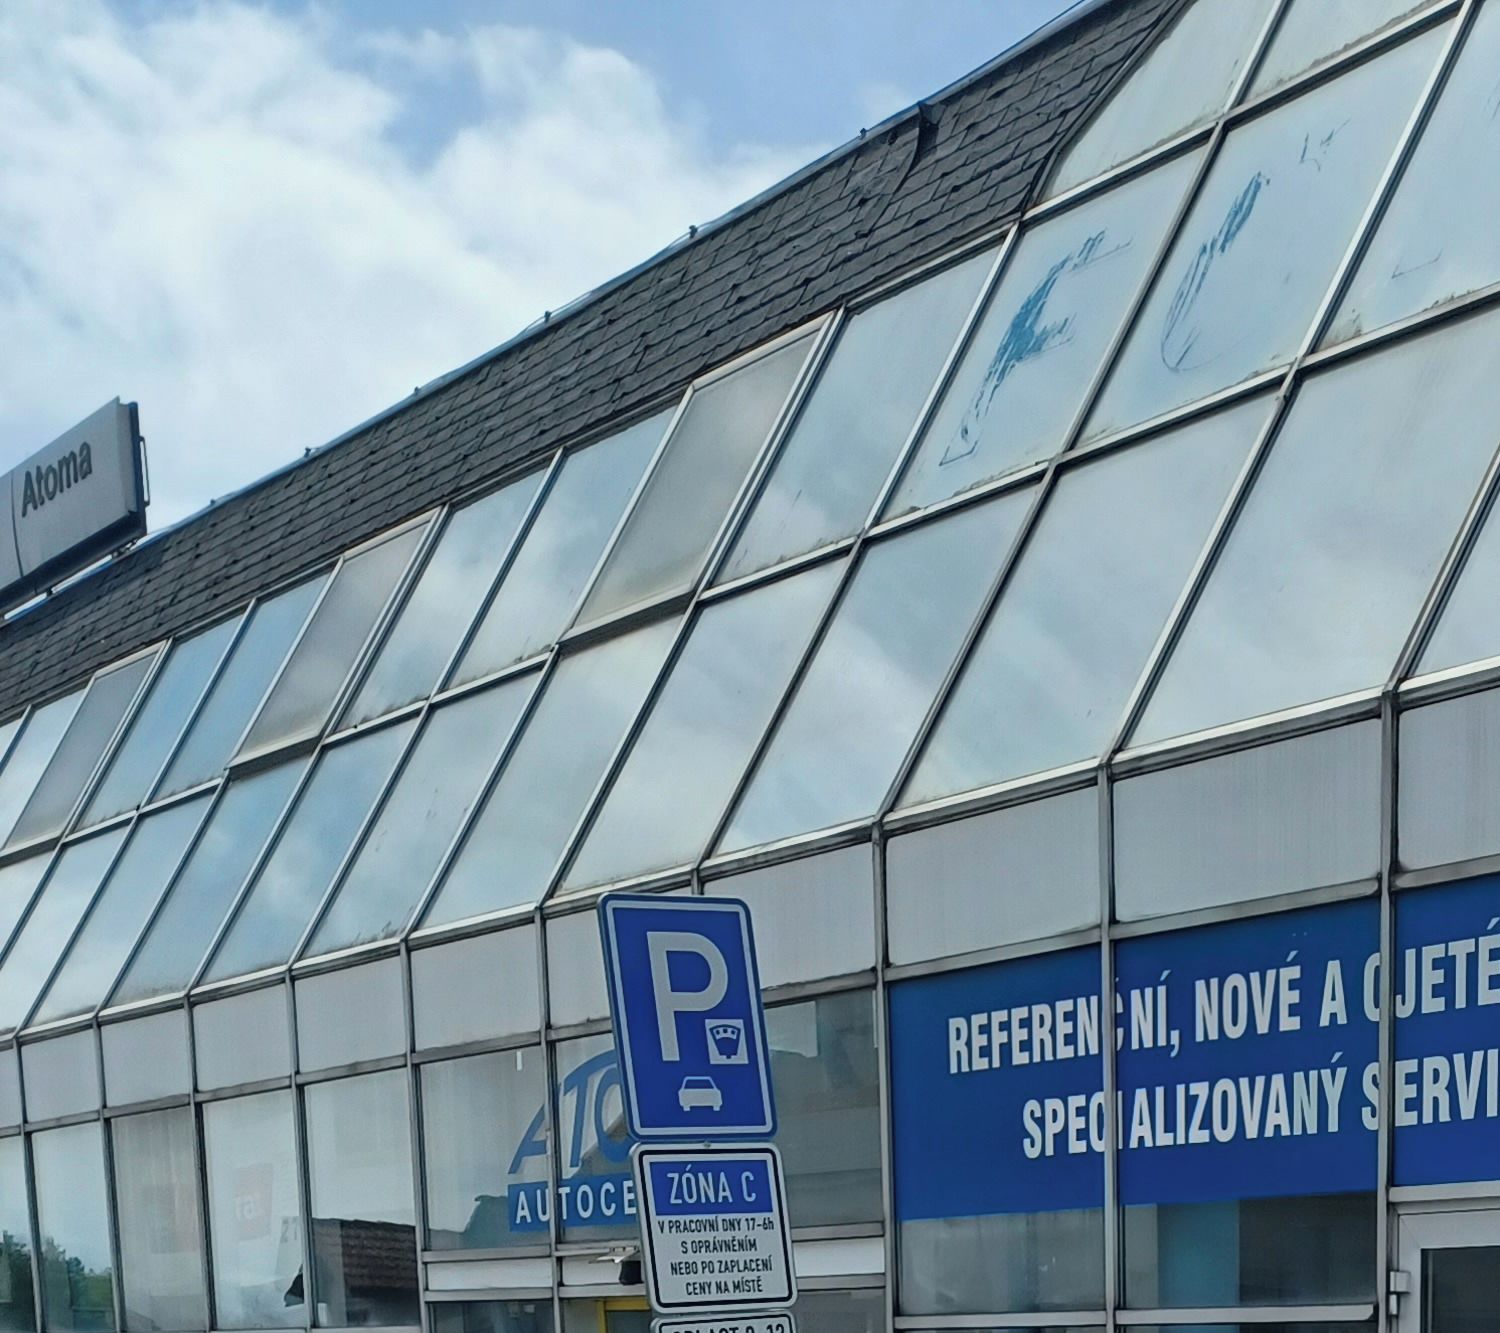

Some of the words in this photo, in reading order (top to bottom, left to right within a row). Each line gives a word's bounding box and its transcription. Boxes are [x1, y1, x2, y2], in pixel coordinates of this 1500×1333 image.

[21, 441, 93, 517] Atoma
[647, 931, 728, 1061] P
[1195, 950, 1301, 1043] NOVÉ
[1319, 959, 1347, 1027] A
[667, 1164, 732, 1204] ZÓNA
[741, 1171, 756, 1202] C
[658, 1220, 666, 1234] V
[668, 1216, 720, 1234] PRACOVNÍ
[722, 1218, 742, 1232] DNY
[745, 1217, 774, 1231] 17-6h
[681, 1241, 689, 1254] S
[691, 1236, 758, 1254] OPRÁVNĚNÍM
[670, 1260, 698, 1276] NEBO
[702, 1260, 715, 1275] PO
[718, 1255, 773, 1274] ZAPLACENÍ
[686, 1281, 712, 1296] CENY
[716, 1281, 730, 1295] NA
[733, 1275, 763, 1293] MÍSTĚ
